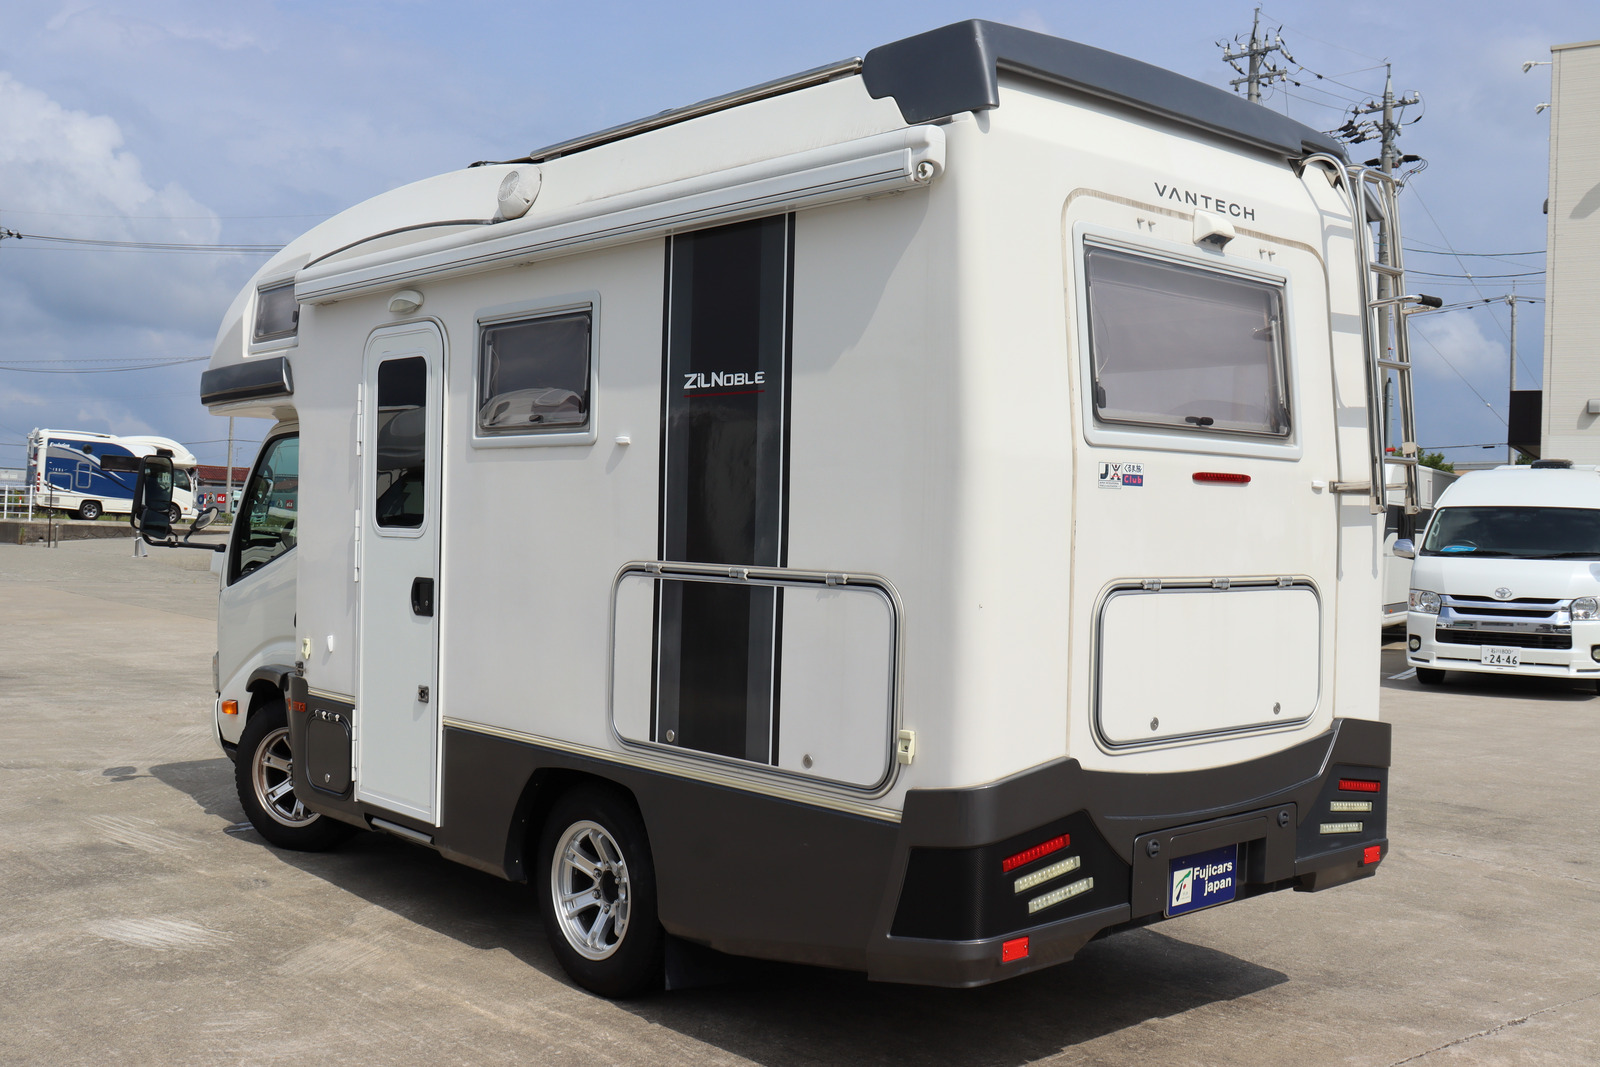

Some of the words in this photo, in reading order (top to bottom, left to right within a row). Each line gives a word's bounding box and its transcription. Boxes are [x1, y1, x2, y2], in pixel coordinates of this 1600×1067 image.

[1154, 182, 1255, 221] VANTECH
[1123, 475, 1143, 484] Club
[1489, 654, 1518, 665] 24-46
[1193, 861, 1233, 881] Fujicars
[1203, 877, 1232, 897] japan
